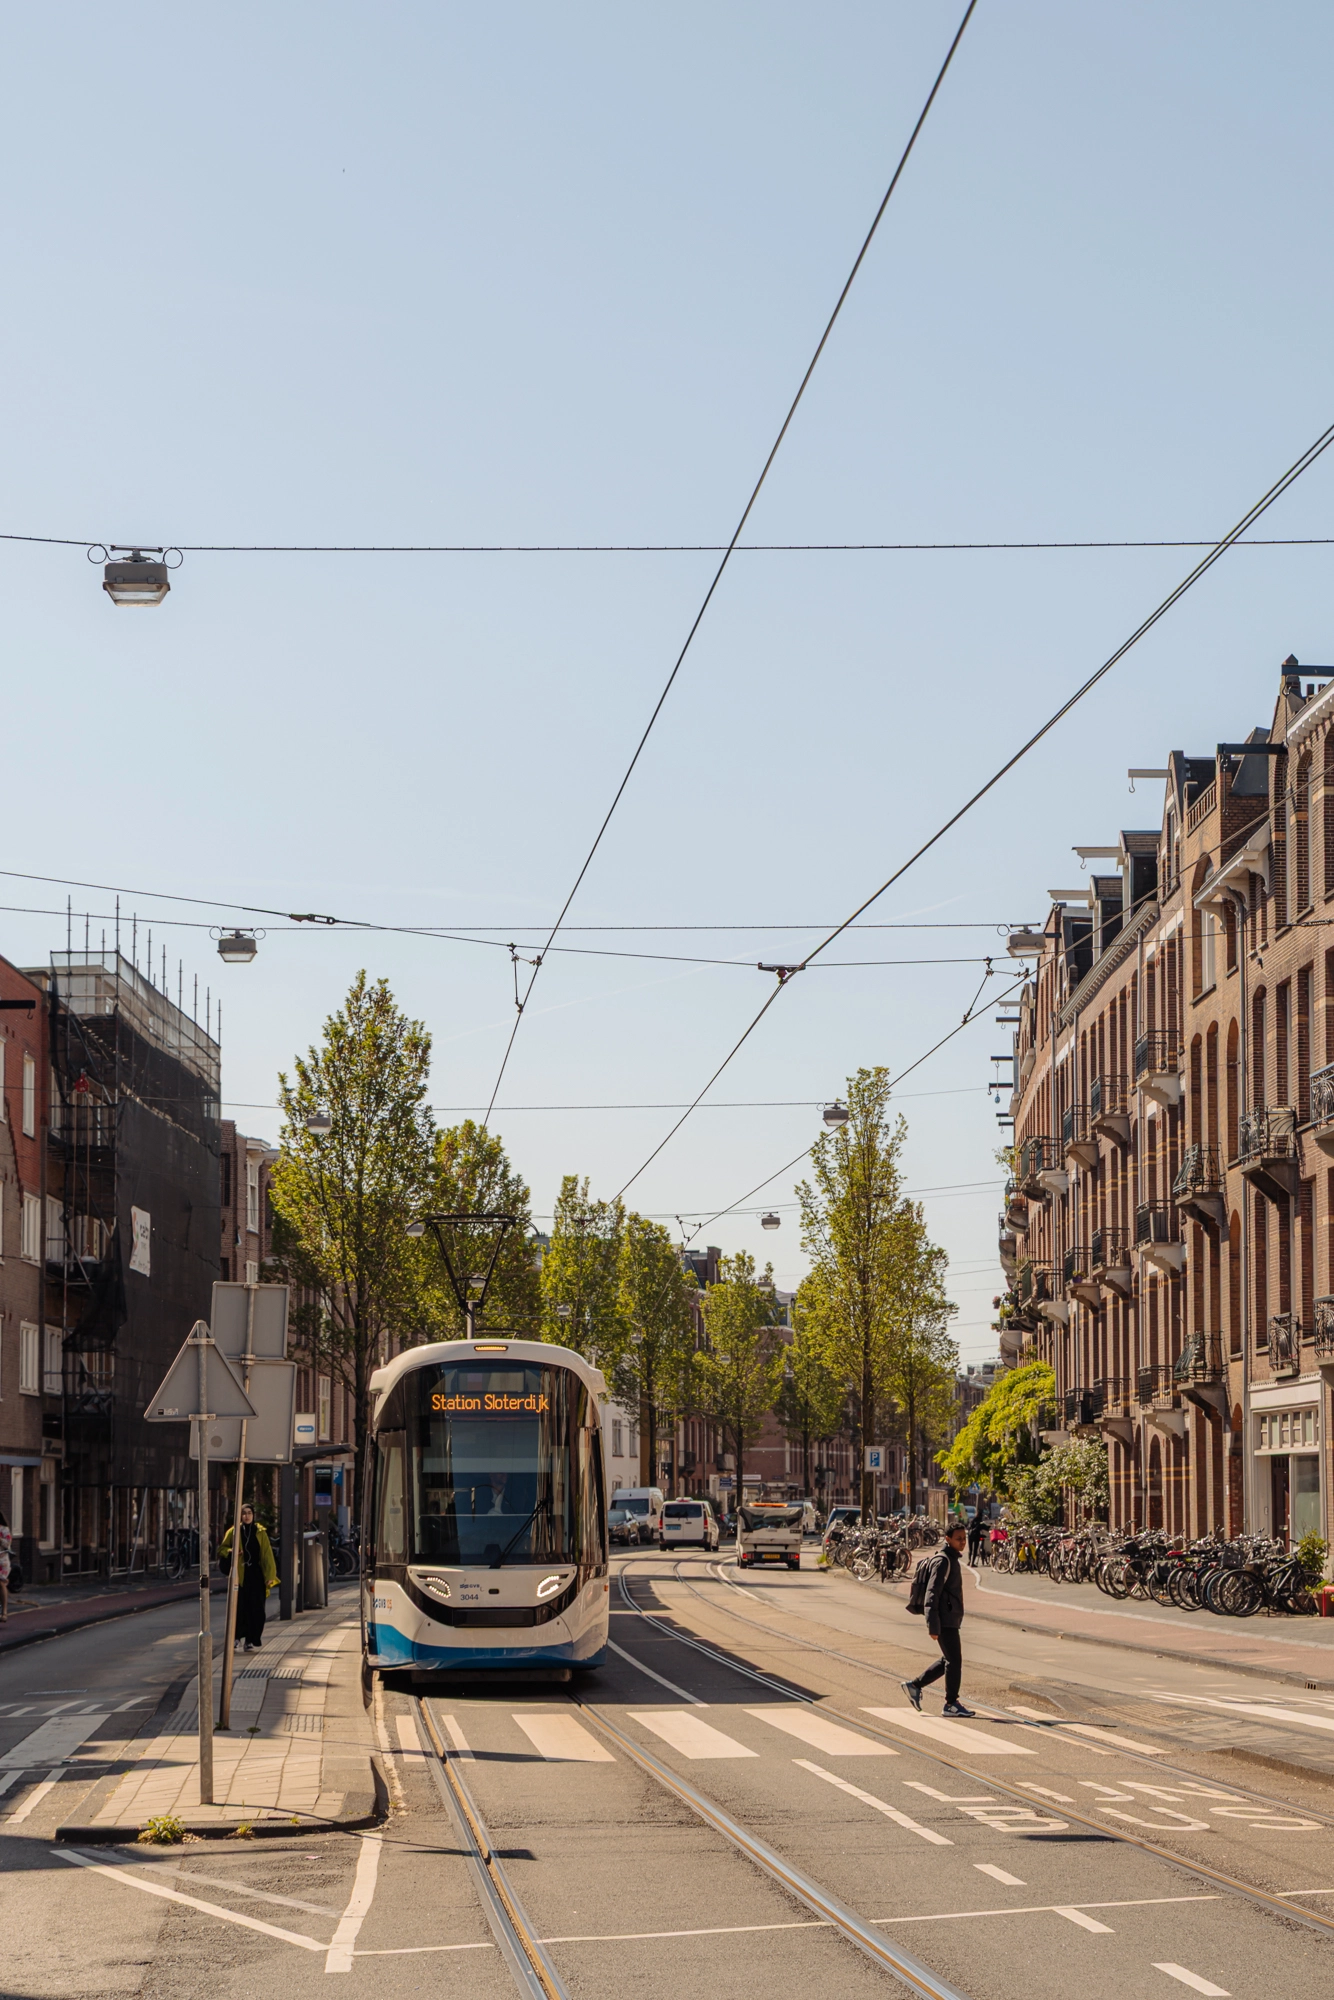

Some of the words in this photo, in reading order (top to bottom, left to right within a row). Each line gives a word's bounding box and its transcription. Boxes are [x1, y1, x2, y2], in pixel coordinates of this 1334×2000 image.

[431, 1393, 481, 1410] Station
[484, 1393, 550, 1413] Sloterdijk
[460, 1593, 479, 1601] 3044
[955, 1806, 1325, 1833] BUS
